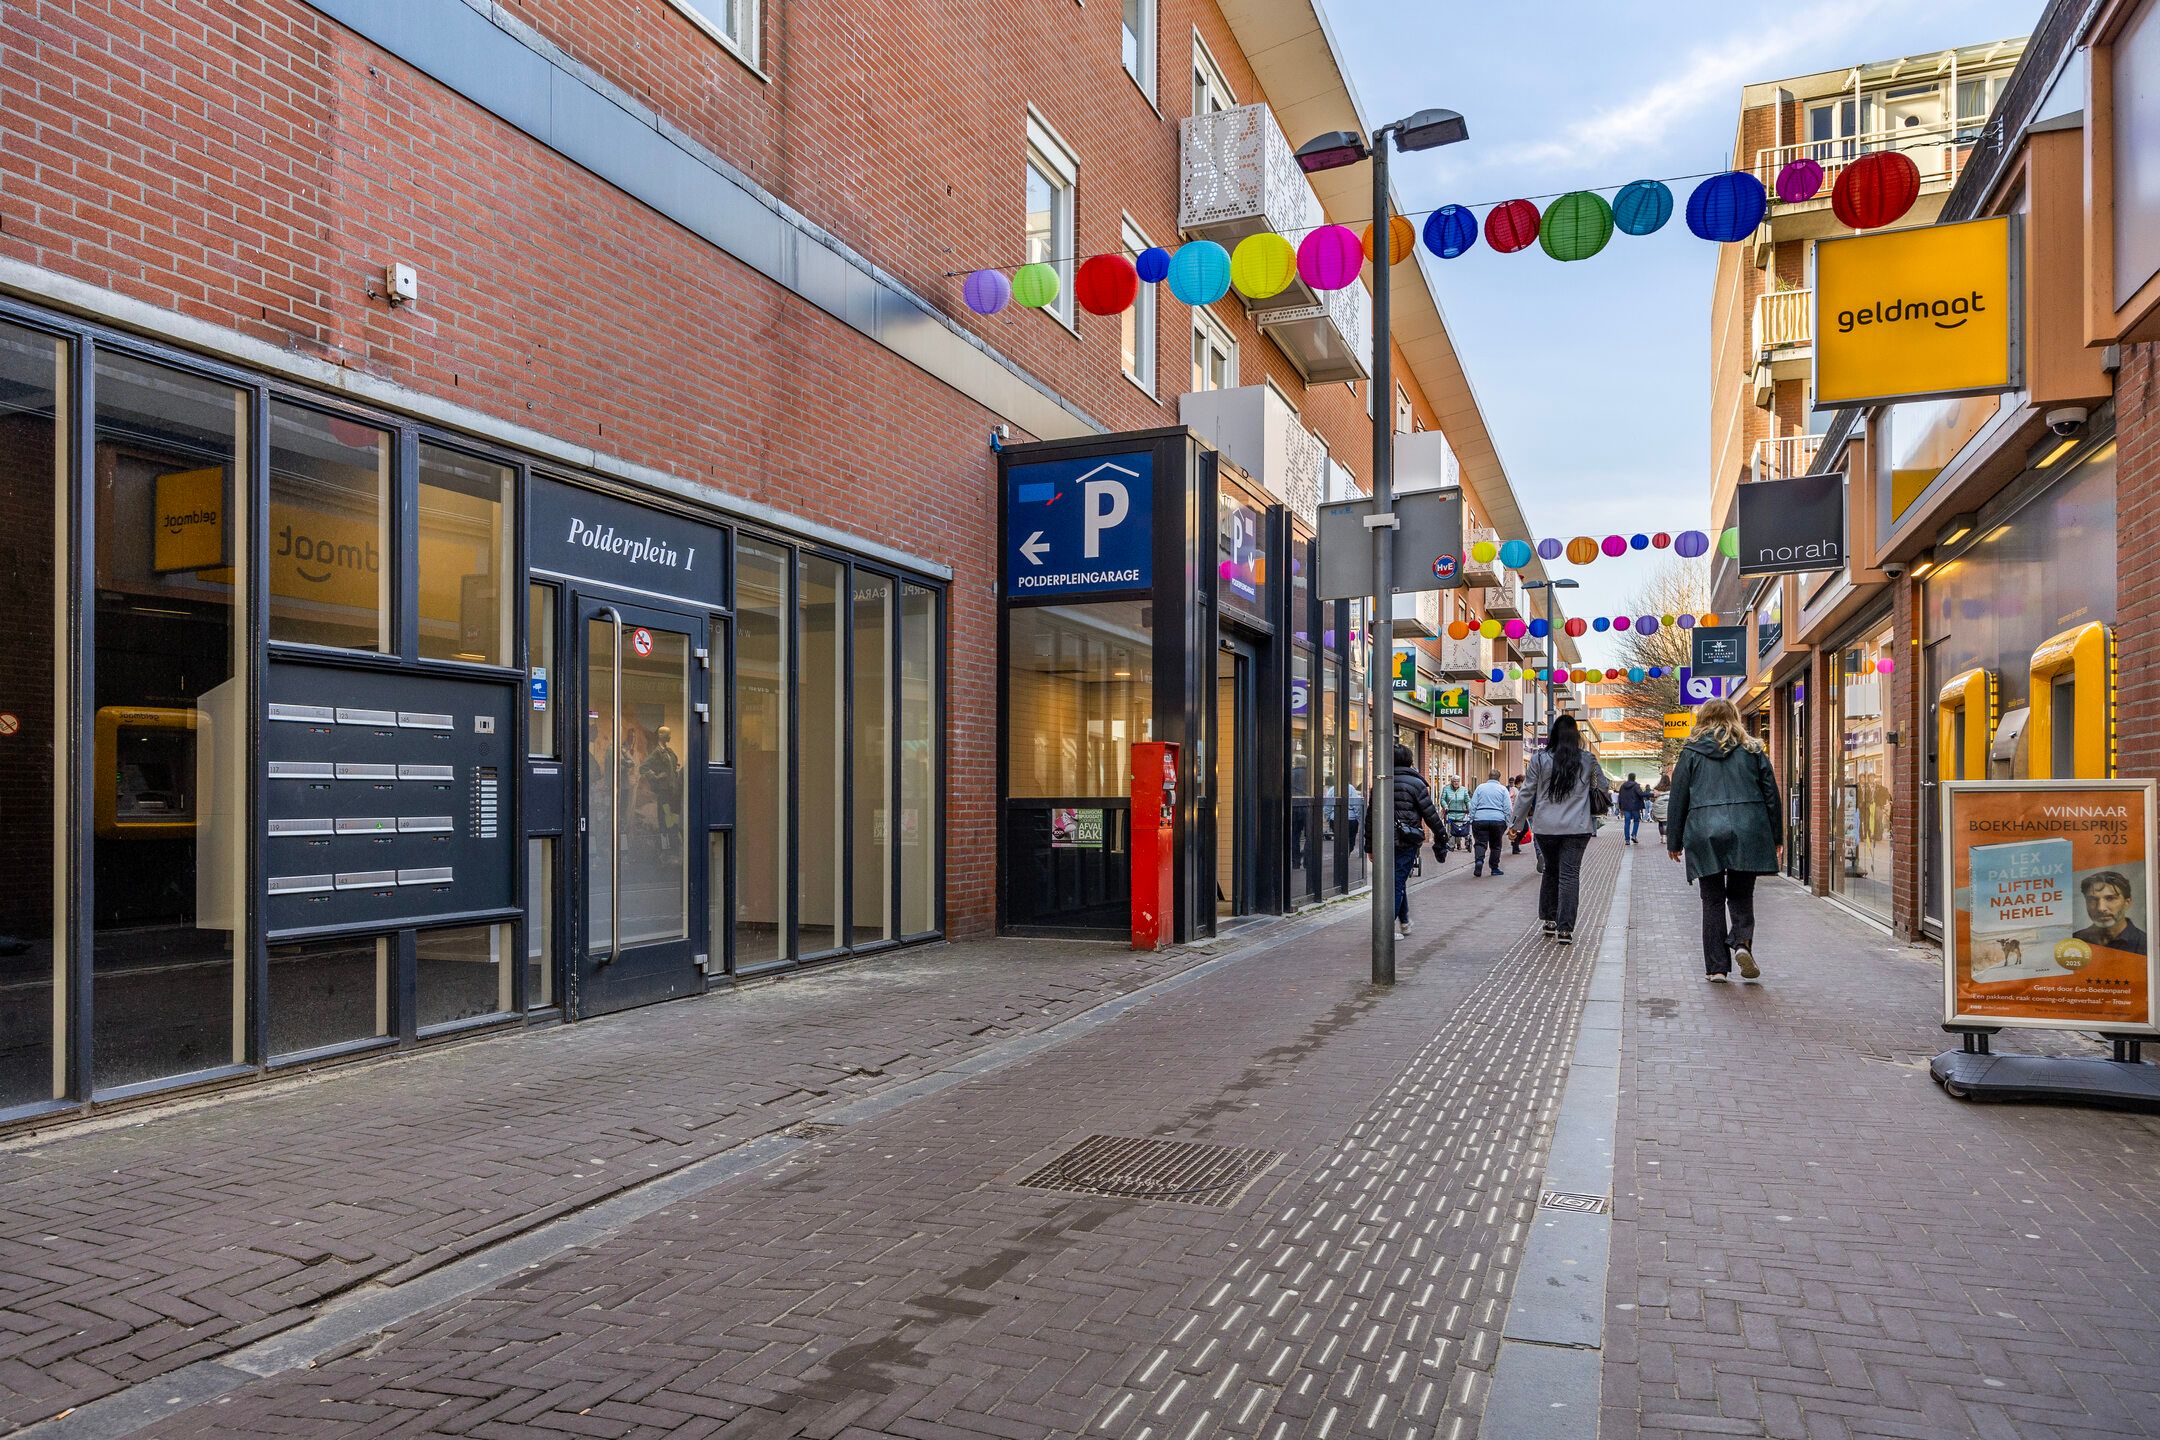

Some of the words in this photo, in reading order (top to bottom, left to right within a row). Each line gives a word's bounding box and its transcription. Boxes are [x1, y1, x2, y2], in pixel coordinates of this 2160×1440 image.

[1838, 291, 1985, 332] geldmaat
[1084, 480, 1130, 558] P
[567, 517, 677, 567] Polderplein
[1760, 539, 1838, 562] norah
[1437, 563, 1454, 571] HvE
[1018, 569, 1140, 588] POLDERPLEINGARAGE
[2043, 806, 2128, 817] WINNAAR
[1079, 822, 1102, 830] AFVAL
[1079, 829, 1102, 839] BAK!
[1969, 820, 2128, 834] BOEKHANDELSPRIJS
[2094, 834, 2128, 845] 2025
[2011, 852, 2040, 865] LEX
[1988, 863, 2064, 881] PALEAUX
[1998, 877, 2054, 894] LIFTEN
[1990, 893, 2036, 908] NAAR
[2041, 890, 2063, 902] DE
[2000, 905, 2054, 920] HEMEL
